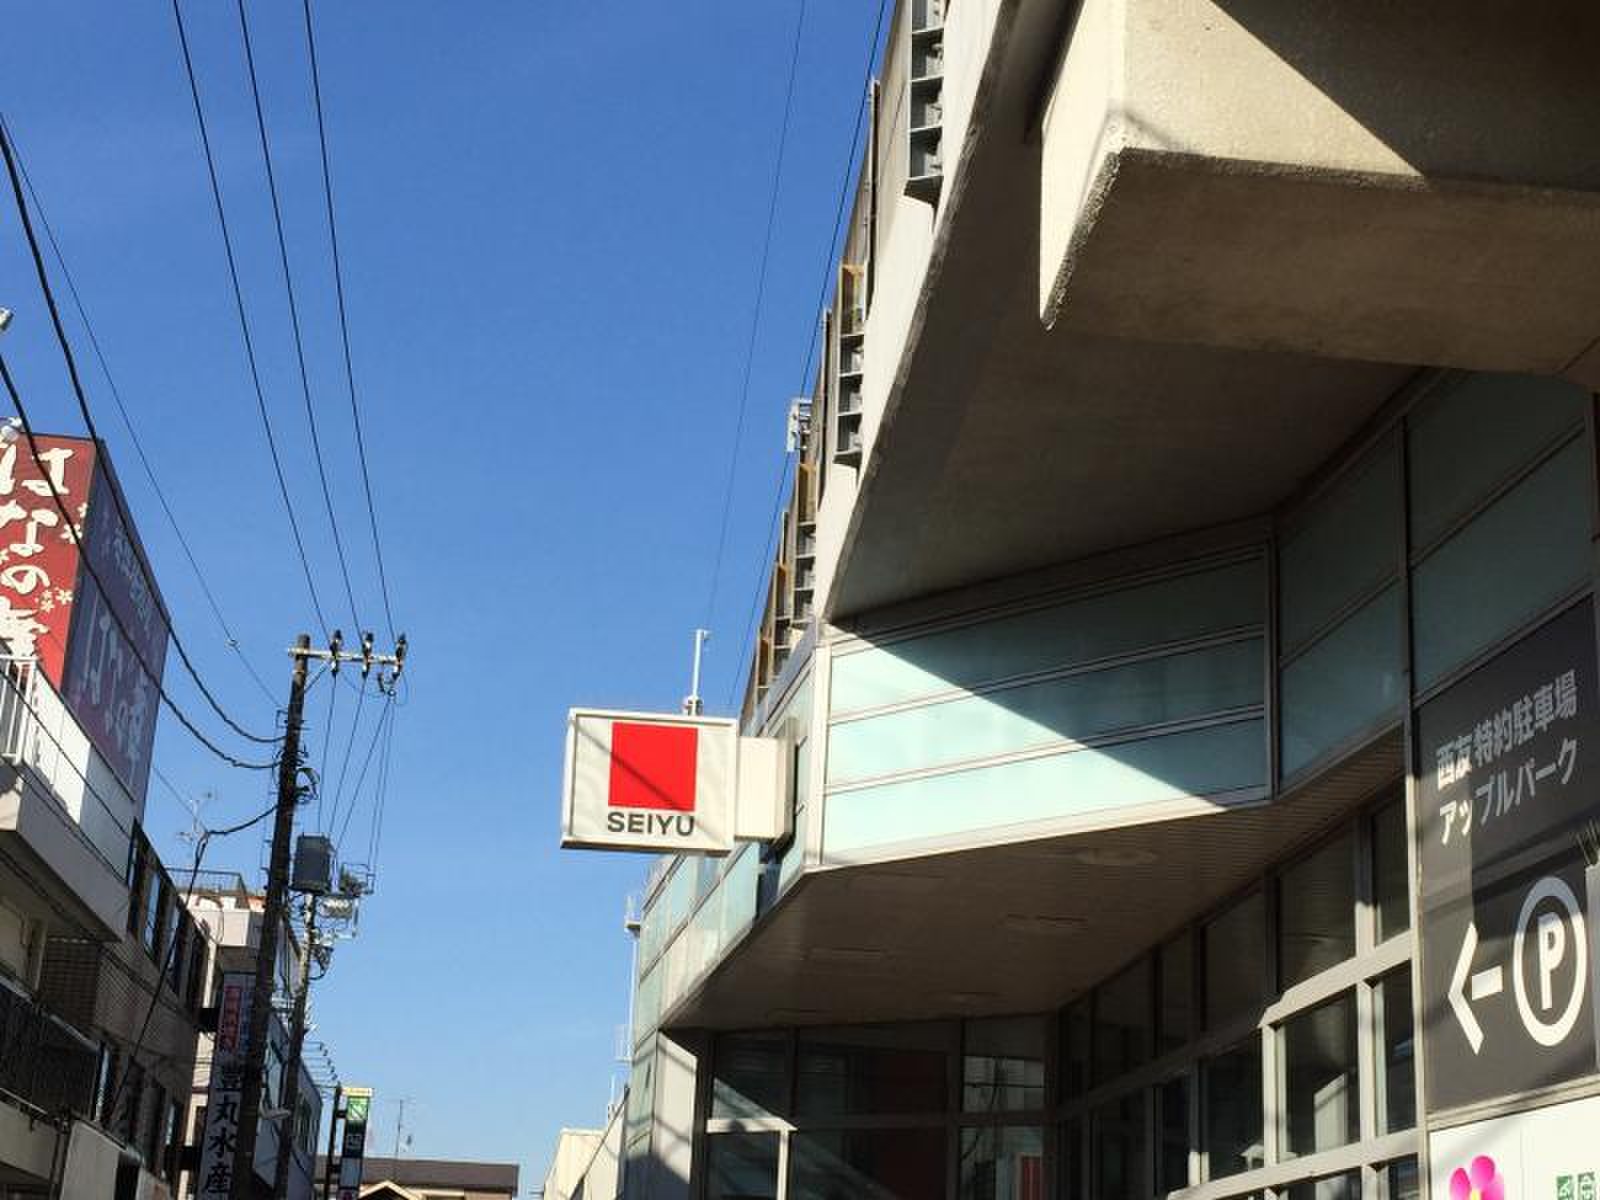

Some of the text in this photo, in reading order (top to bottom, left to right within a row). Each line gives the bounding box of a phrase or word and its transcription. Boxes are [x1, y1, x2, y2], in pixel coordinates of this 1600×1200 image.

[1436, 669, 1577, 790] 西友特約駐車場
[607, 811, 695, 837] SEIYU
[1440, 738, 1577, 845] アップルパーク
[1537, 911, 1565, 1010] P
